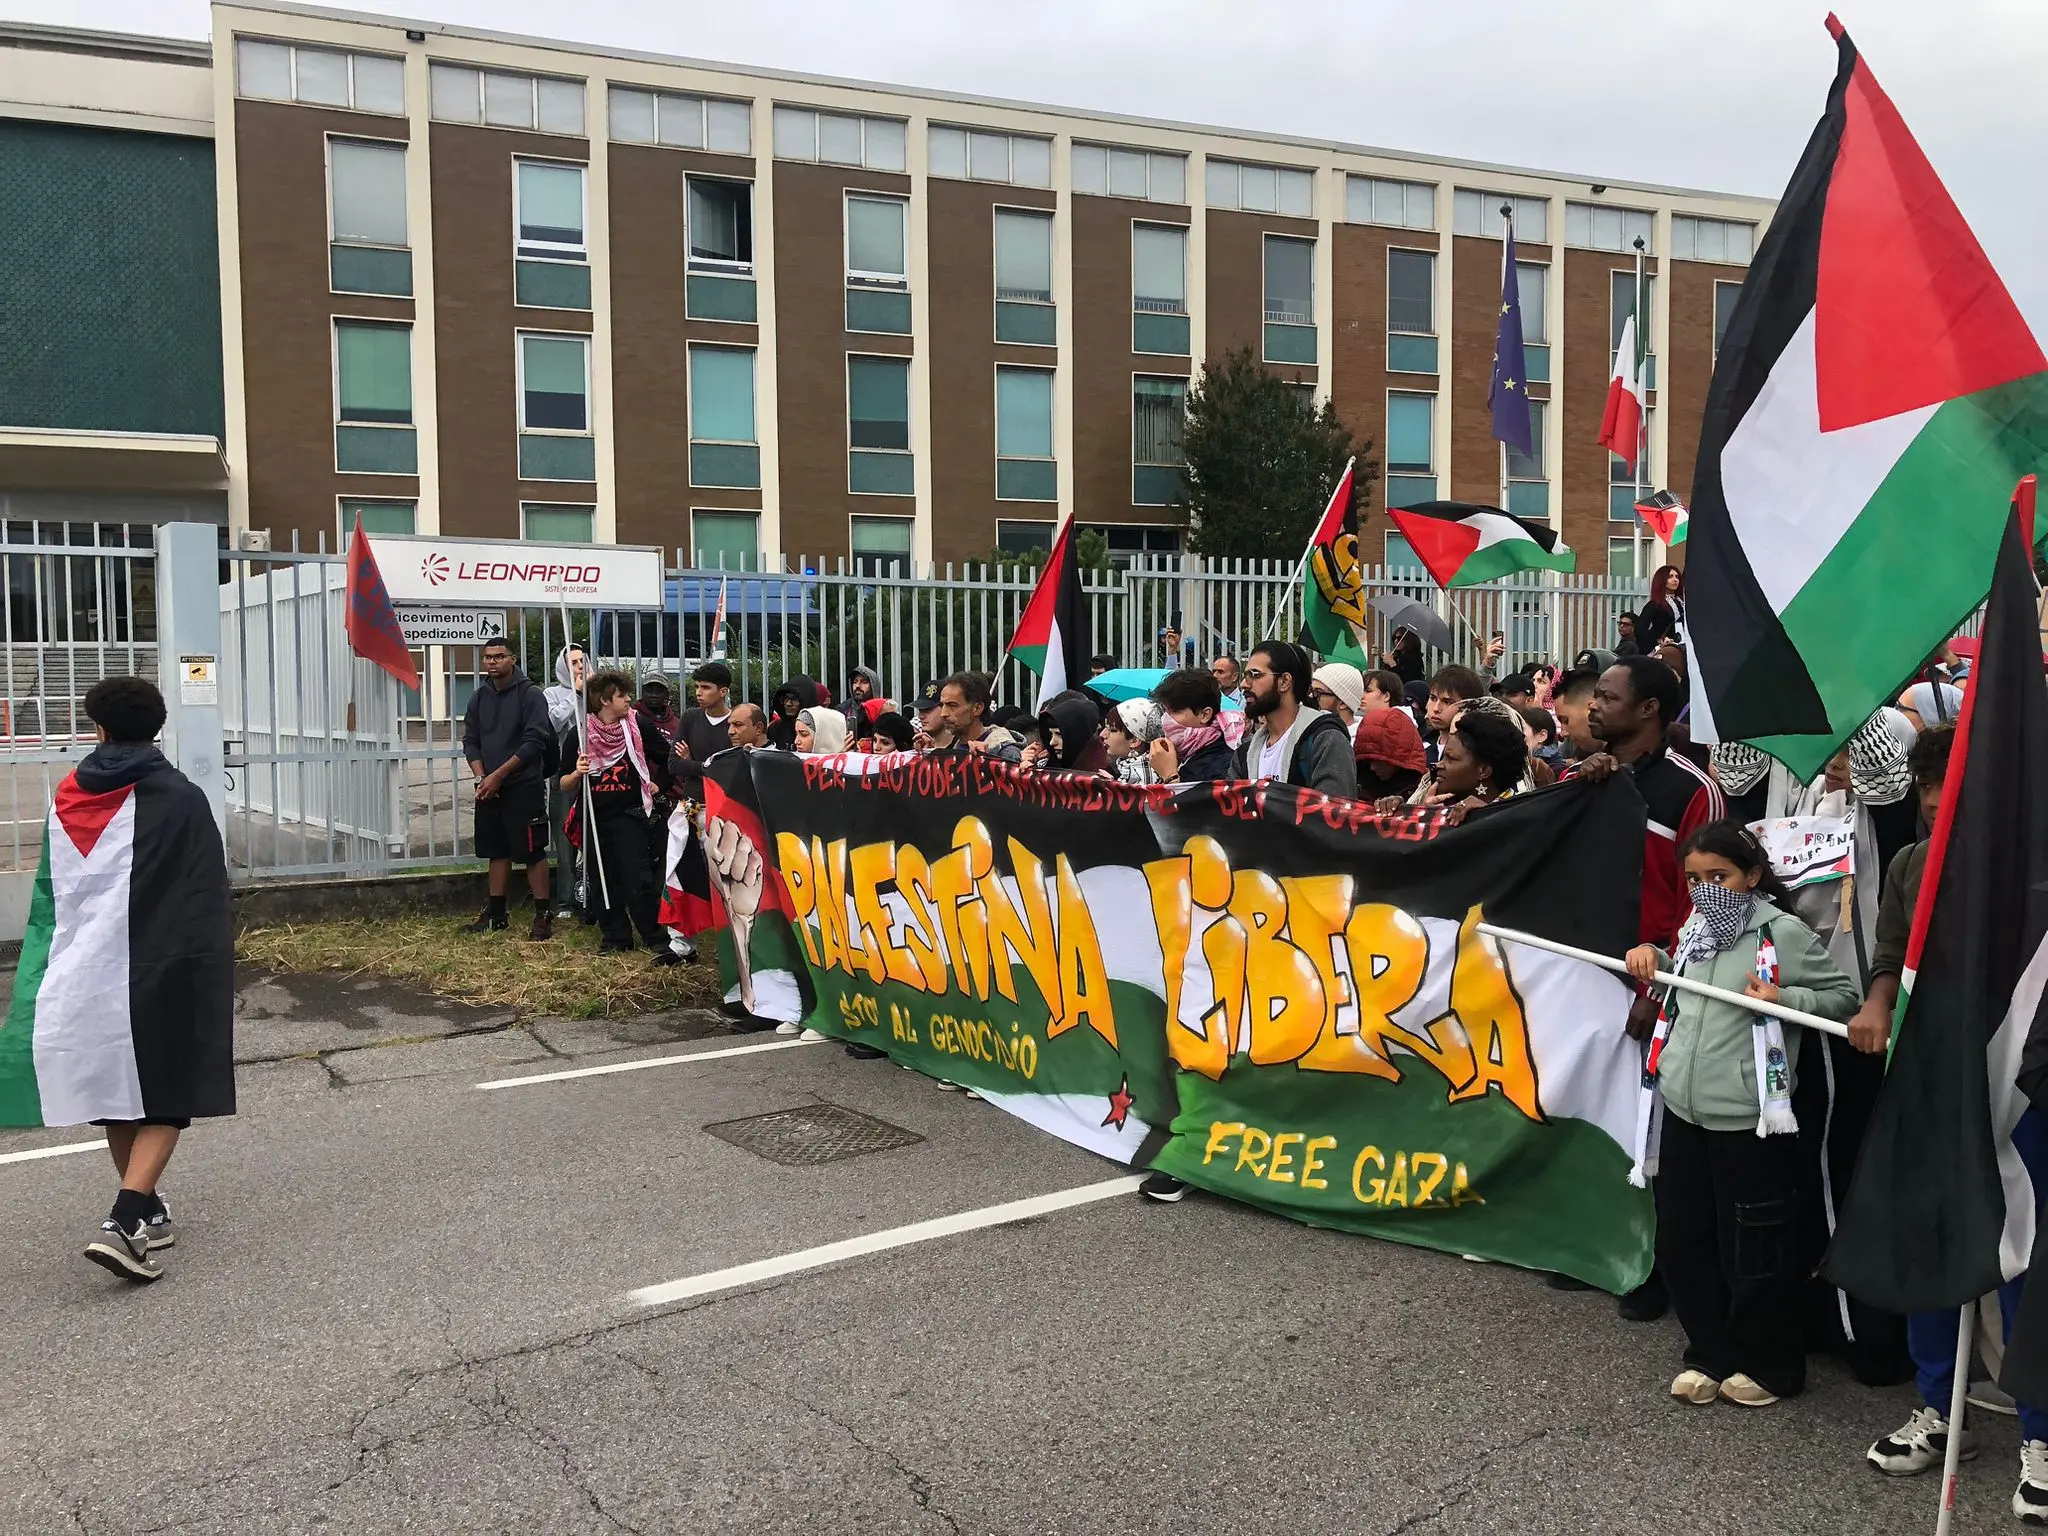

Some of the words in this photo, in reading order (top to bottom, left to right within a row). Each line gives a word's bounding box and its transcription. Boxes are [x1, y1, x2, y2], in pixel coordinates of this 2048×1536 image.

[457, 562, 601, 583] LEONARDO
[396, 611, 475, 624] icevimento
[404, 628, 475, 641] spedizione
[803, 752, 848, 792] PER
[889, 1001, 919, 1044] AL
[1202, 1121, 1338, 1190] FREE
[1351, 1145, 1486, 1209] GAZA
